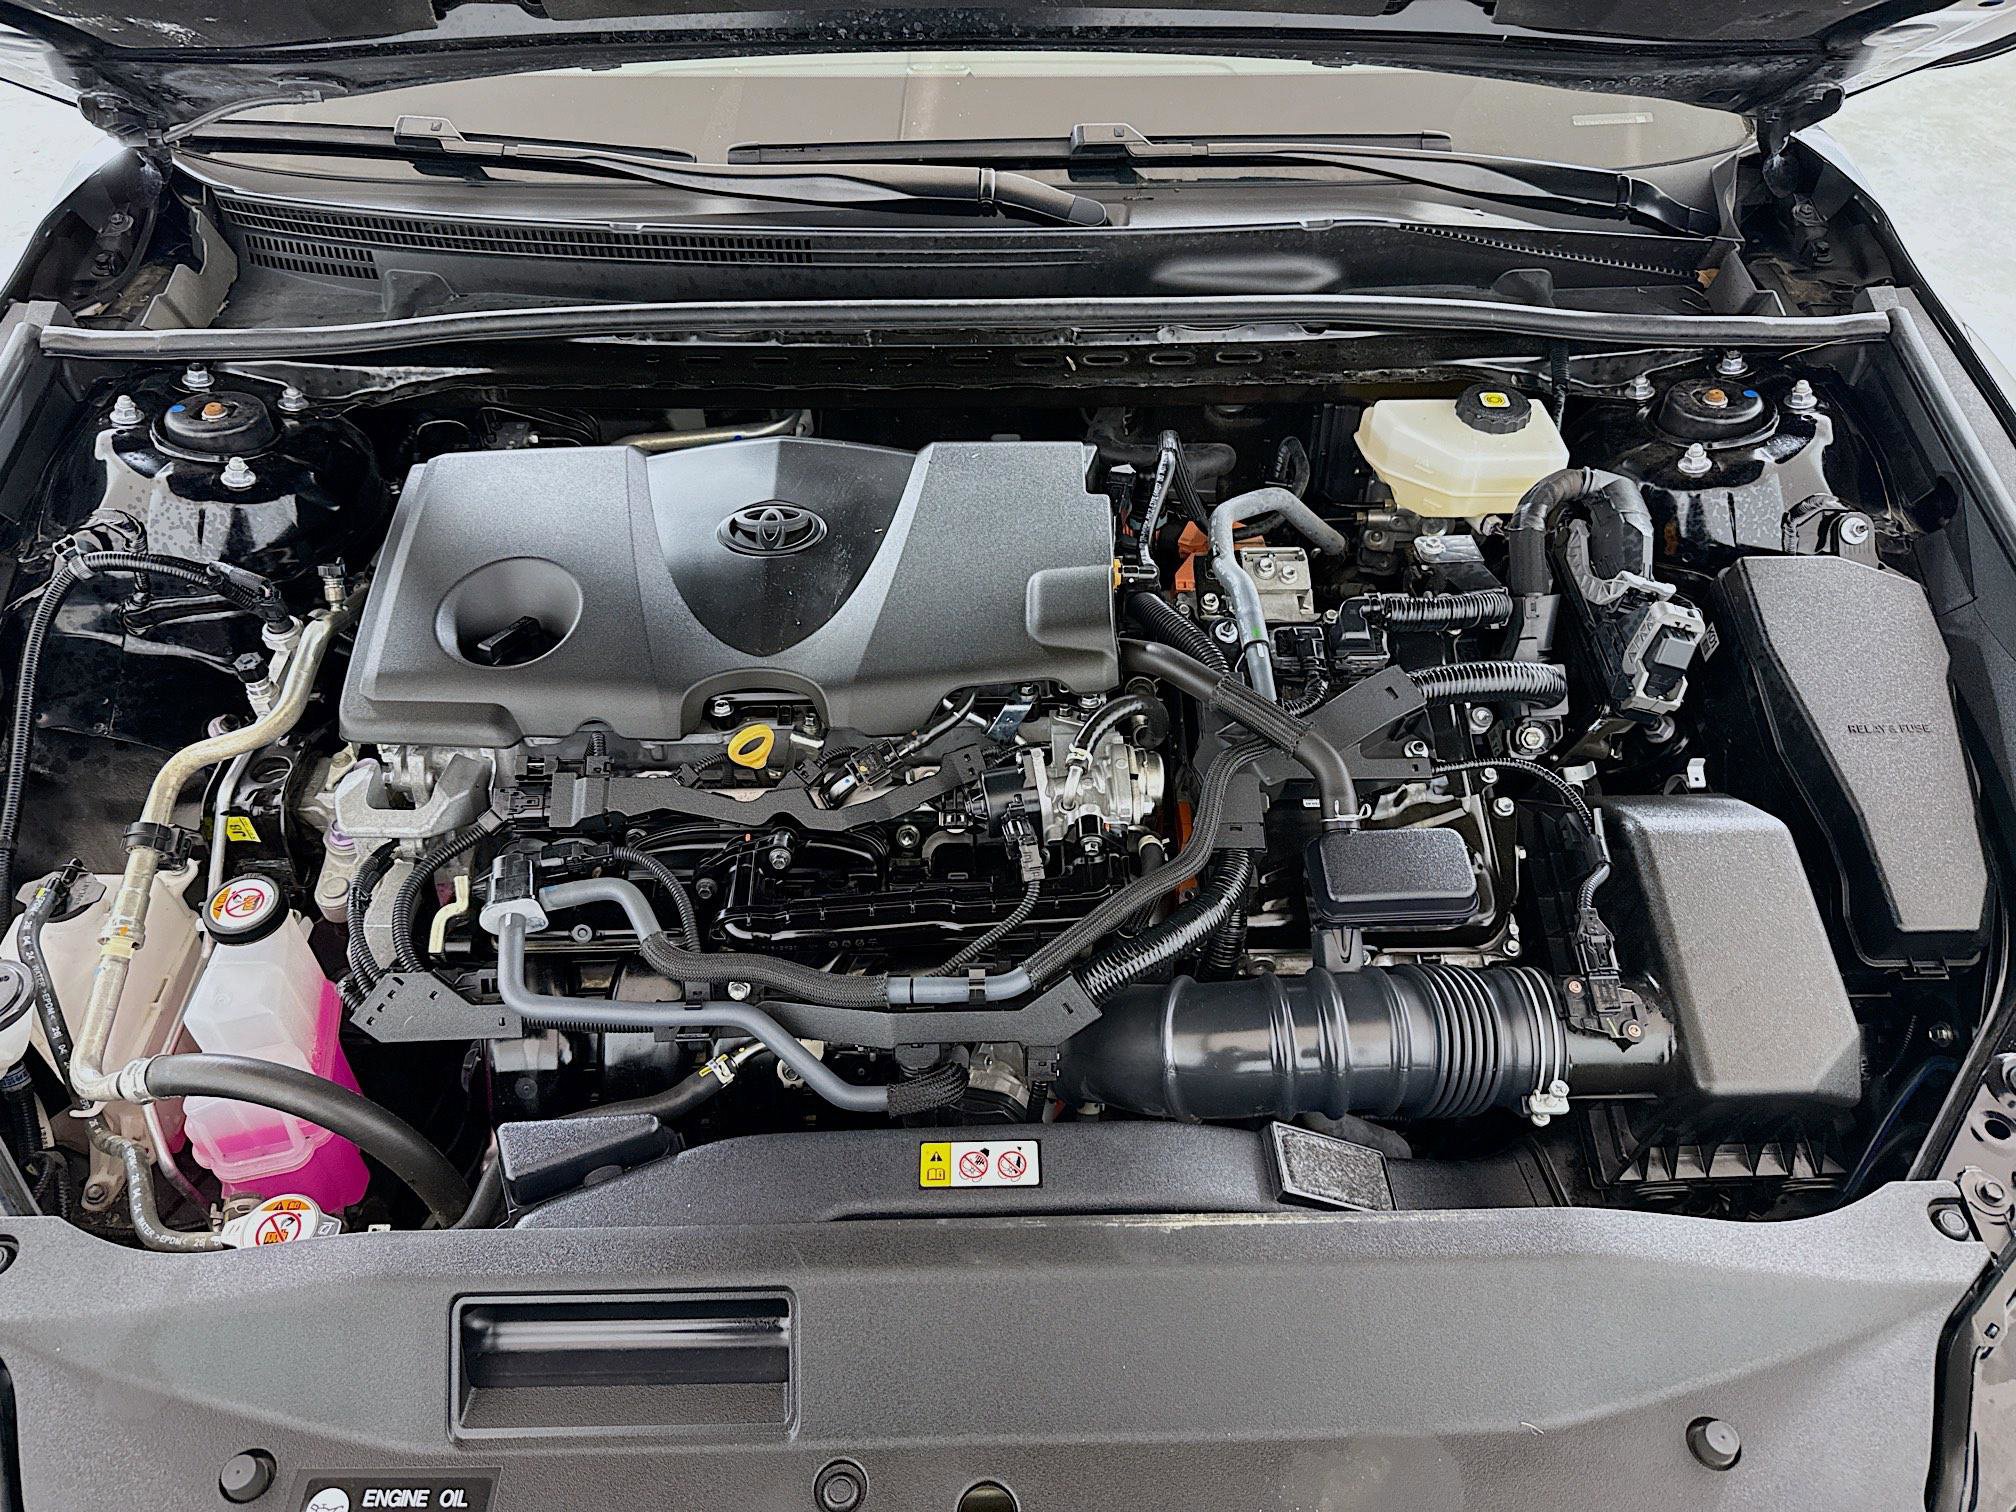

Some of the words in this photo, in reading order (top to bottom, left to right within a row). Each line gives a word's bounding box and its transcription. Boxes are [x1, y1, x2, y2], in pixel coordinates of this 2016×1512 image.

[1847, 724, 1885, 734] RELAY
[1899, 724, 1931, 734] FUSE
[32, 965, 46, 988] WATER
[138, 1216, 156, 1238] WATER
[362, 1489, 430, 1508] ENGINE
[439, 1489, 468, 1508] OIL
